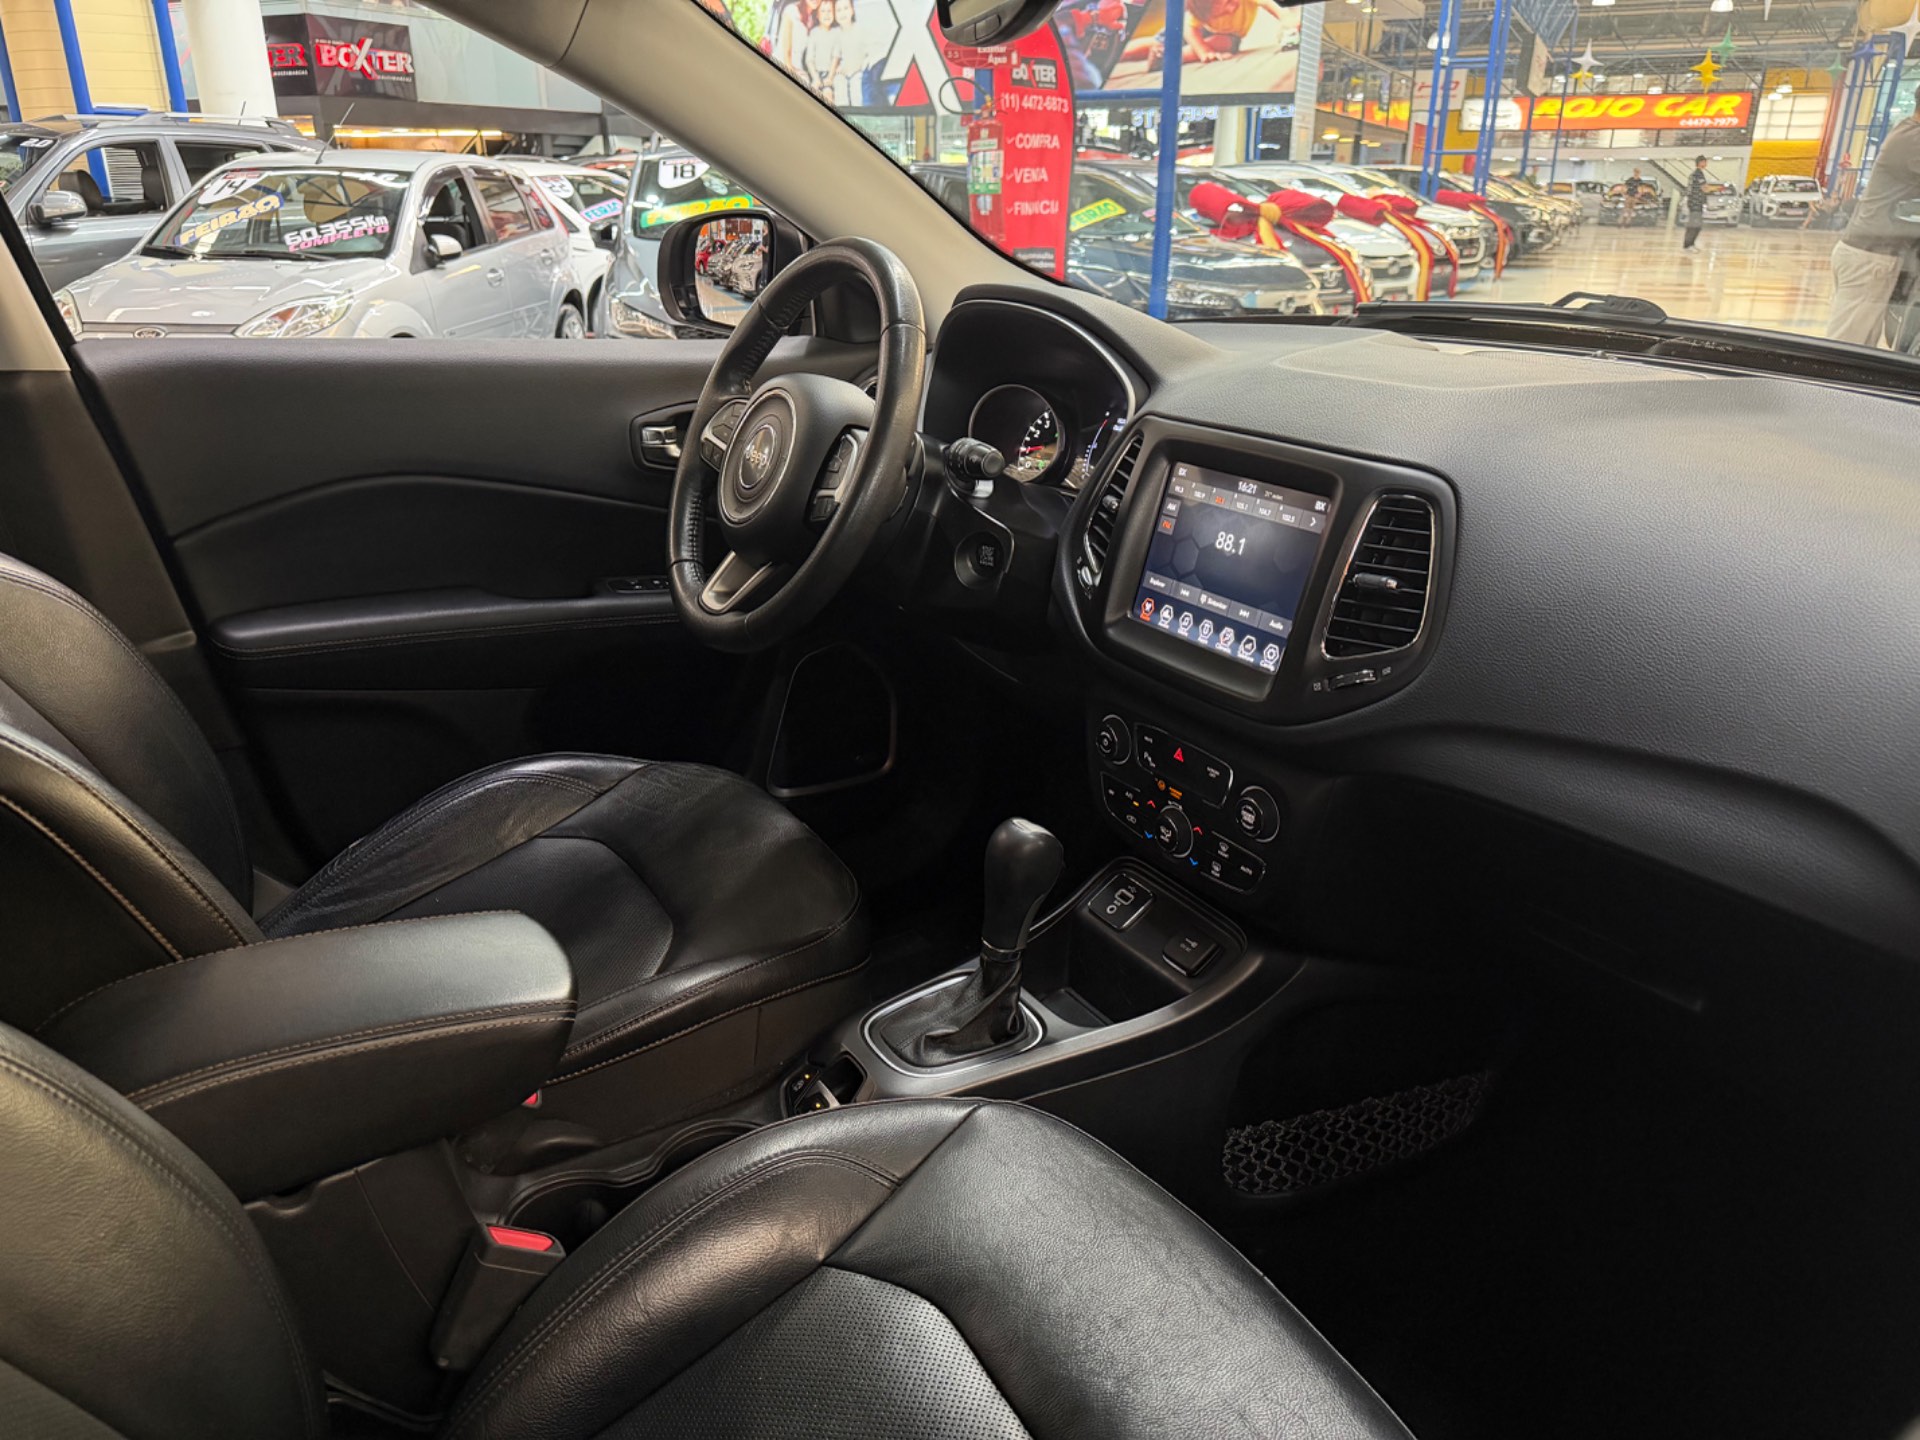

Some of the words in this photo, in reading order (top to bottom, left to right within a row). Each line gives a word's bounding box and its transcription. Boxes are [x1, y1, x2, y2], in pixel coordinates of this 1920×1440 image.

[316, 38, 414, 80] BOXTER
[1532, 98, 1645, 118] ROJO
[1654, 95, 1742, 117] CAR
[672, 164, 696, 179] 18
[288, 225, 390, 252] COMPLETO
[1214, 531, 1246, 556] 88.1
